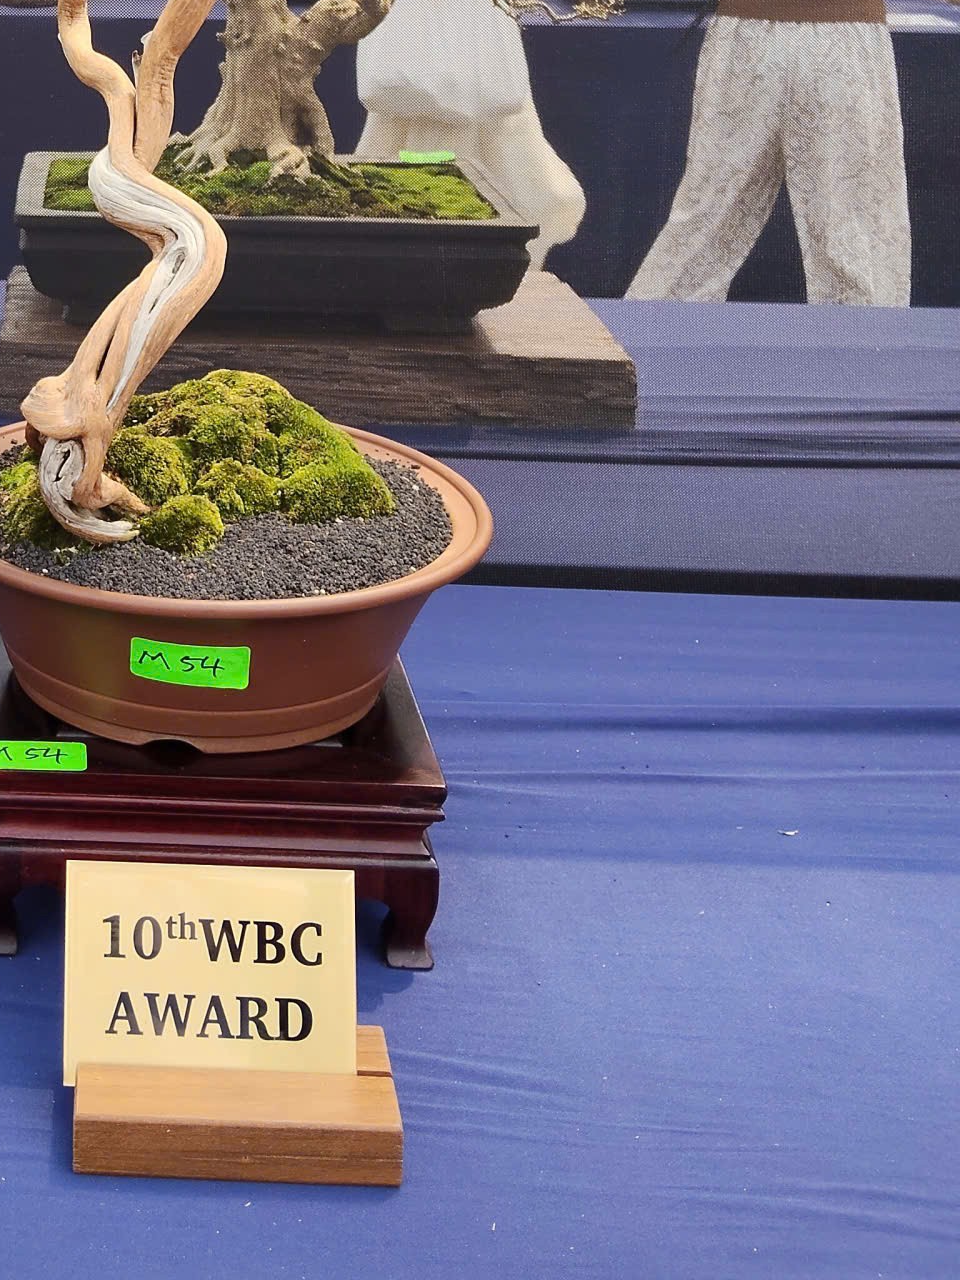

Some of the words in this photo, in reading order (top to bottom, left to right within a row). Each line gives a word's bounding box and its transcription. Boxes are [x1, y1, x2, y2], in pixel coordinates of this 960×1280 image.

[138, 651, 170, 670] M
[180, 656, 225, 677] 54
[25, 748, 68, 764] 54
[104, 991, 314, 1042] AWARD
